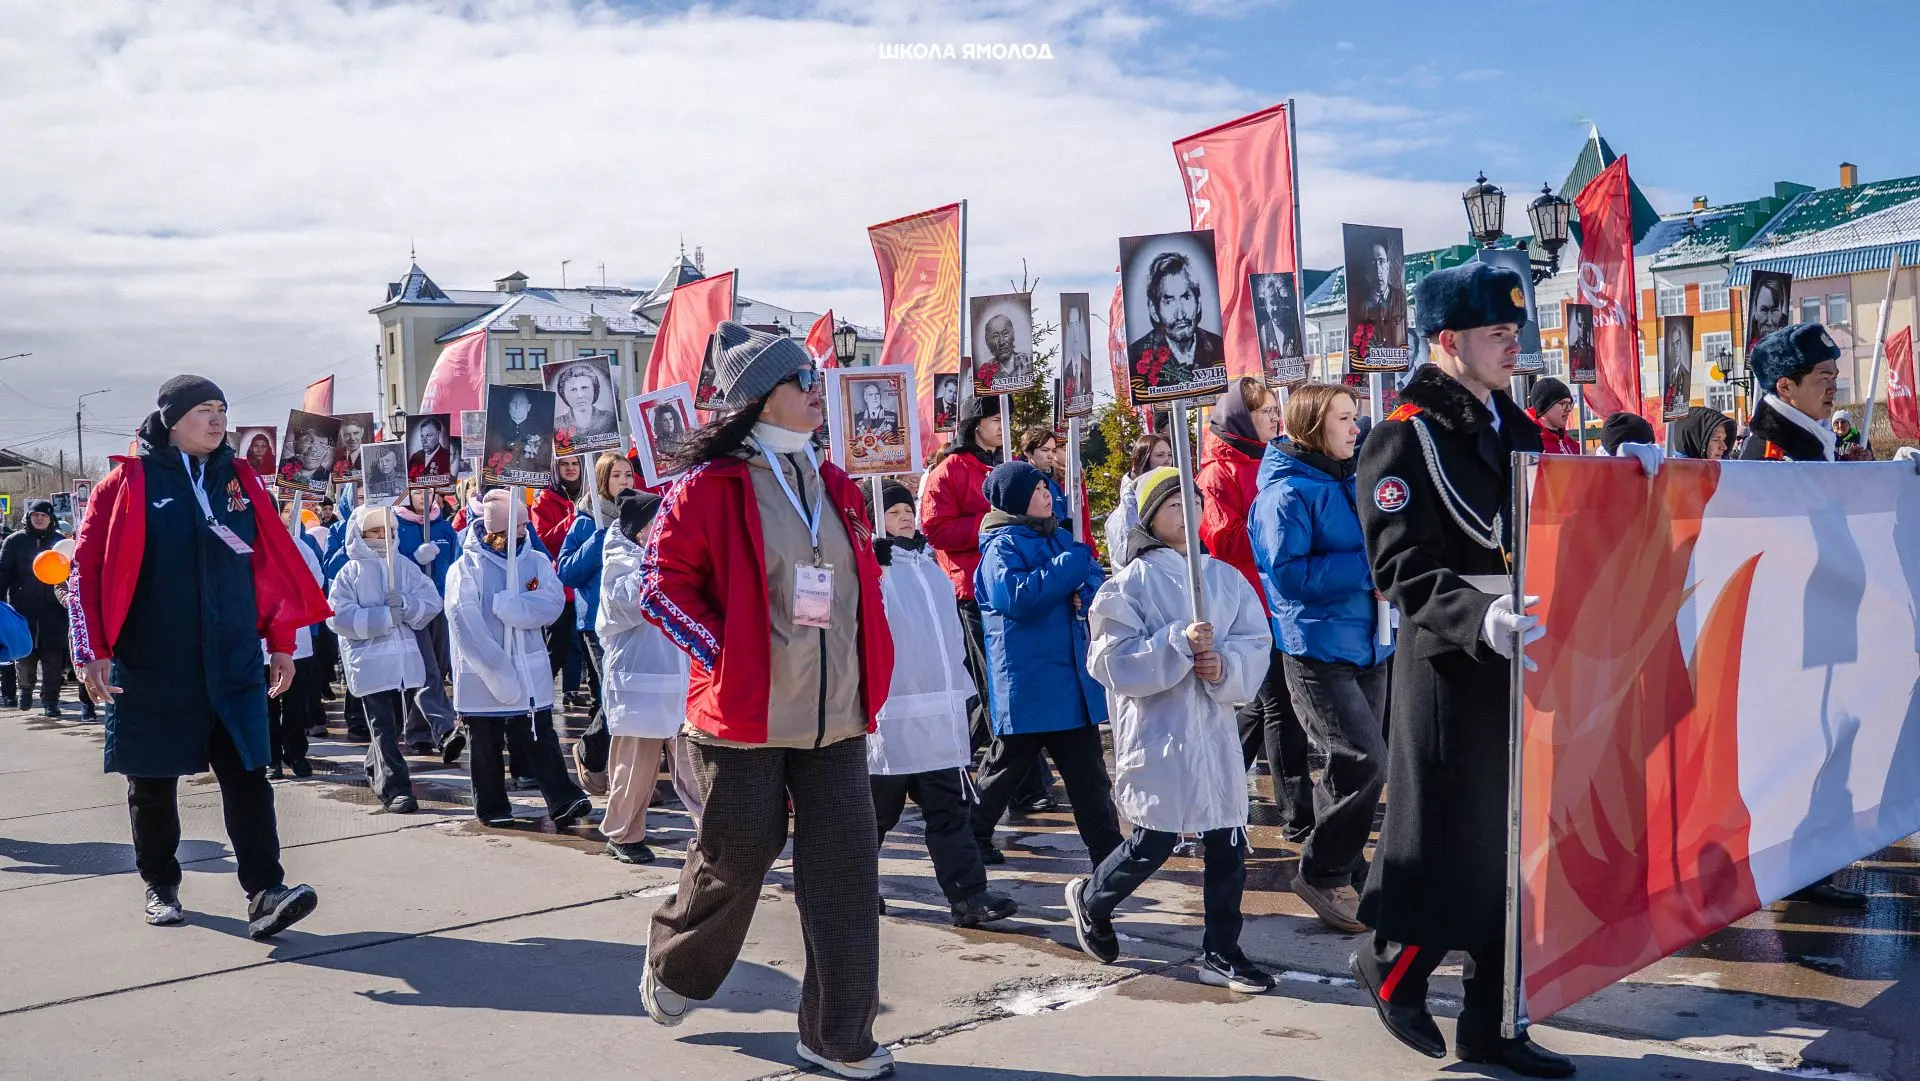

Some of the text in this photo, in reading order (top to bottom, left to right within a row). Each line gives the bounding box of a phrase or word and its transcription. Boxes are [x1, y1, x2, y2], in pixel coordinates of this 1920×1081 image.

[1370, 348, 1408, 358] БАКШЕЕВ
[1193, 367, 1226, 381] ХУДИ
[1148, 383, 1185, 395] Николай
